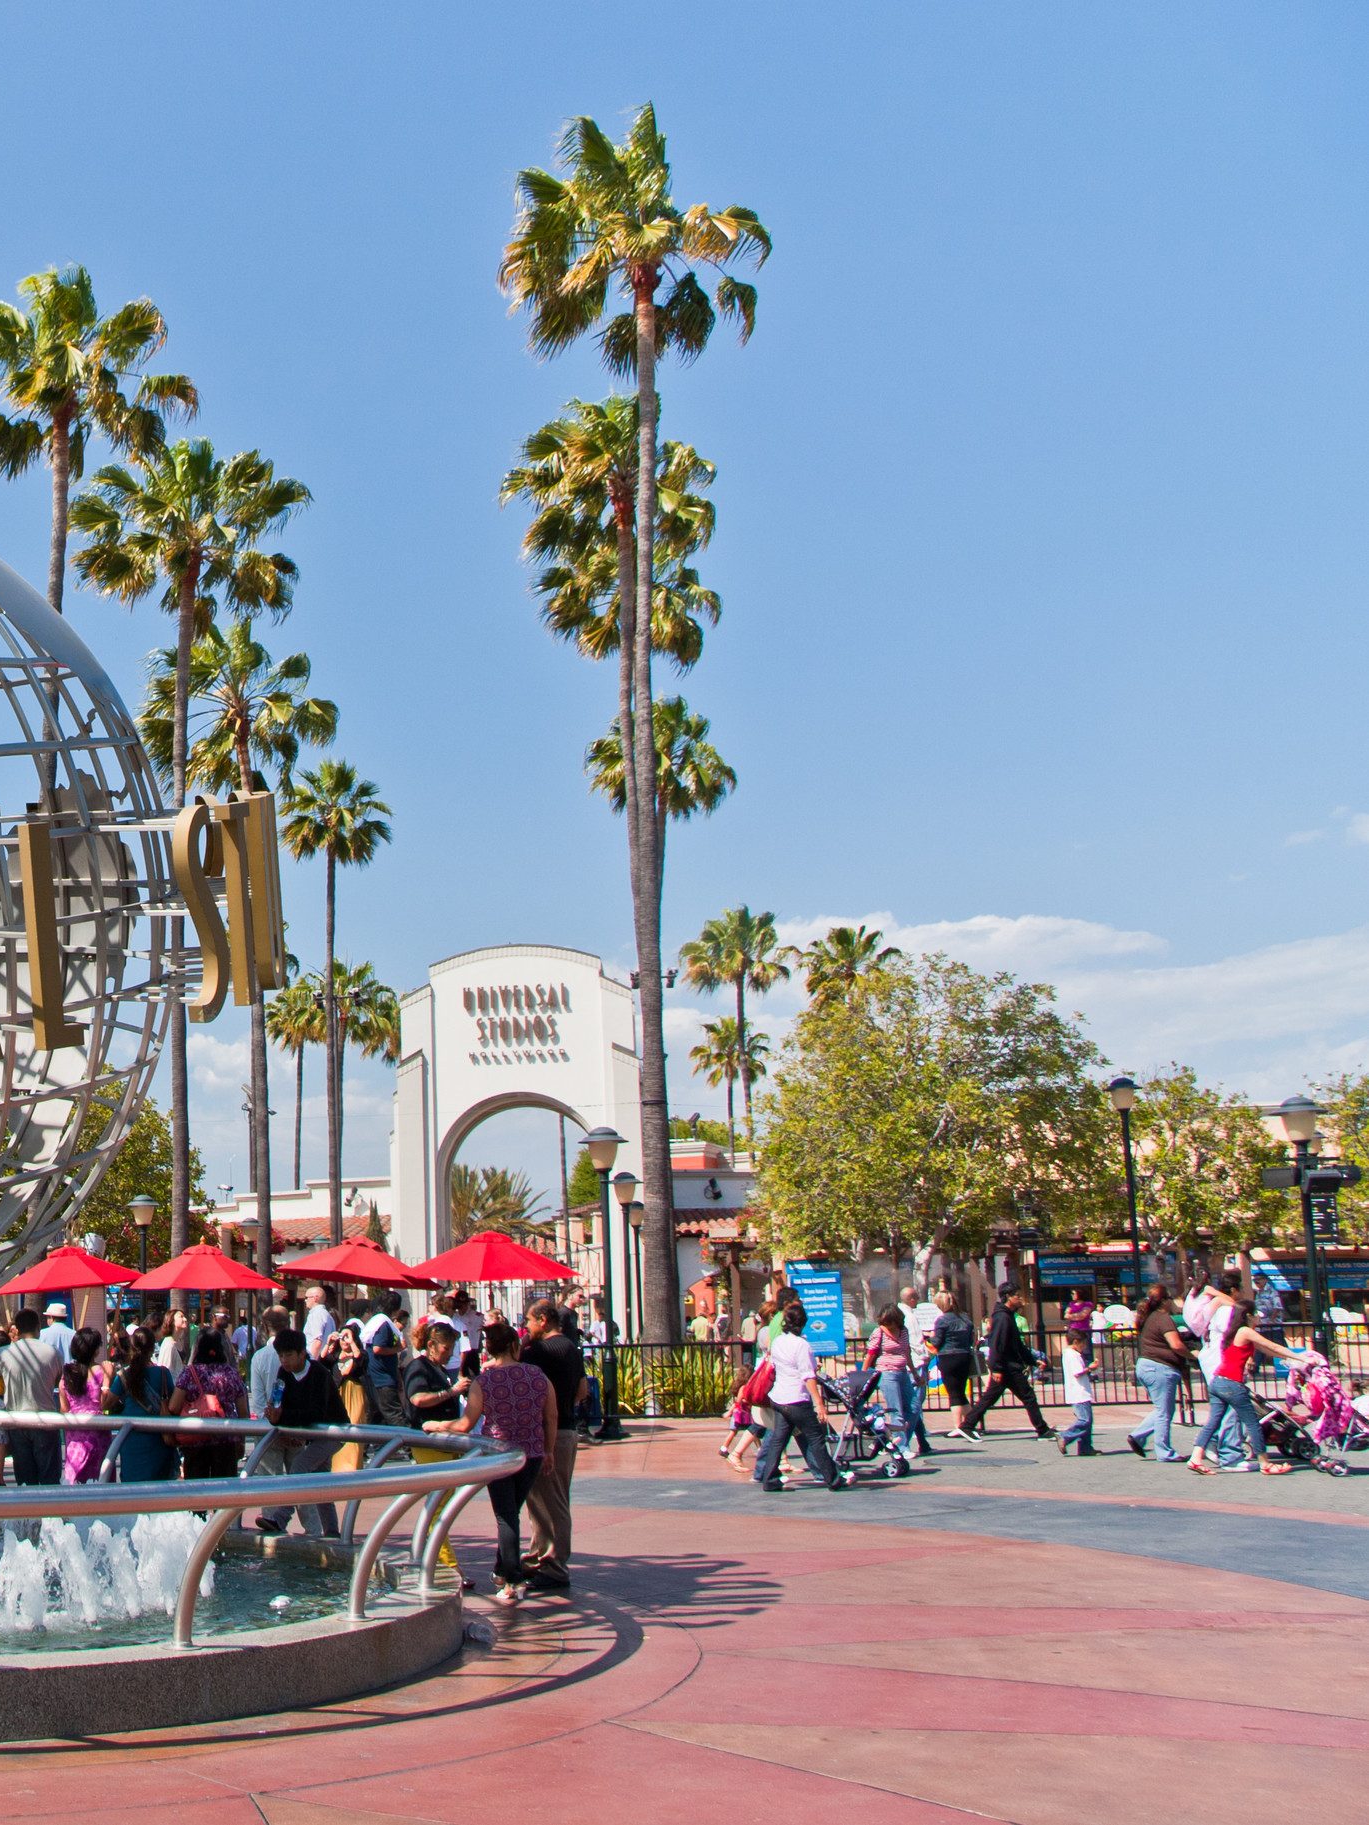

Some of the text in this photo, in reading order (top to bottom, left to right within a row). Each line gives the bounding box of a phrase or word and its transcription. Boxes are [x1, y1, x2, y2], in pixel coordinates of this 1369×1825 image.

[463, 982, 571, 1014] UNIVERSAL
[476, 1015, 558, 1045] STUDIOS
[469, 1049, 568, 1063] HOLLYWOOD
